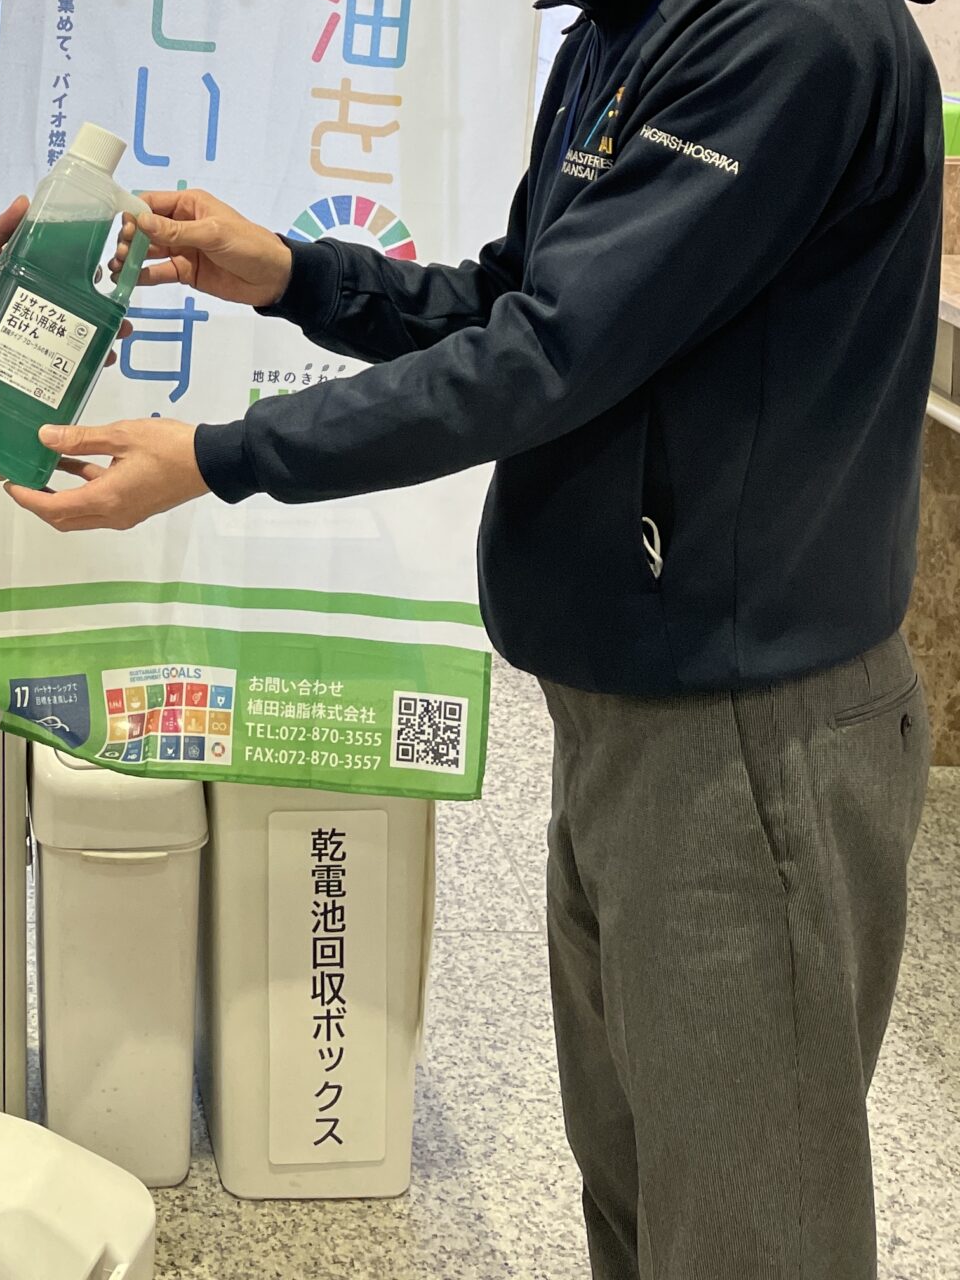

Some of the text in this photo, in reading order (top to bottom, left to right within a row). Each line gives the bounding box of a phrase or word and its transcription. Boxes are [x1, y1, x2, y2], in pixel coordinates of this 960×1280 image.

[19, 292, 66, 323] リサイクル
[7, 314, 40, 339] 石けん
[12, 302, 68, 338] 手洗い用液体
[53, 357, 69, 373] 2L
[252, 370, 338, 385] 地球のきれ
[162, 667, 202, 679] GOALS
[14, 686, 30, 708] 17
[248, 675, 344, 699] お問い合わせ
[246, 700, 377, 725] 植田油脂株式会社
[245, 723, 383, 748] TEL:072-870-3555
[245, 747, 382, 771] FAX:072-870-3557
[310, 827, 346, 1146] 乾電池回収ボックス
